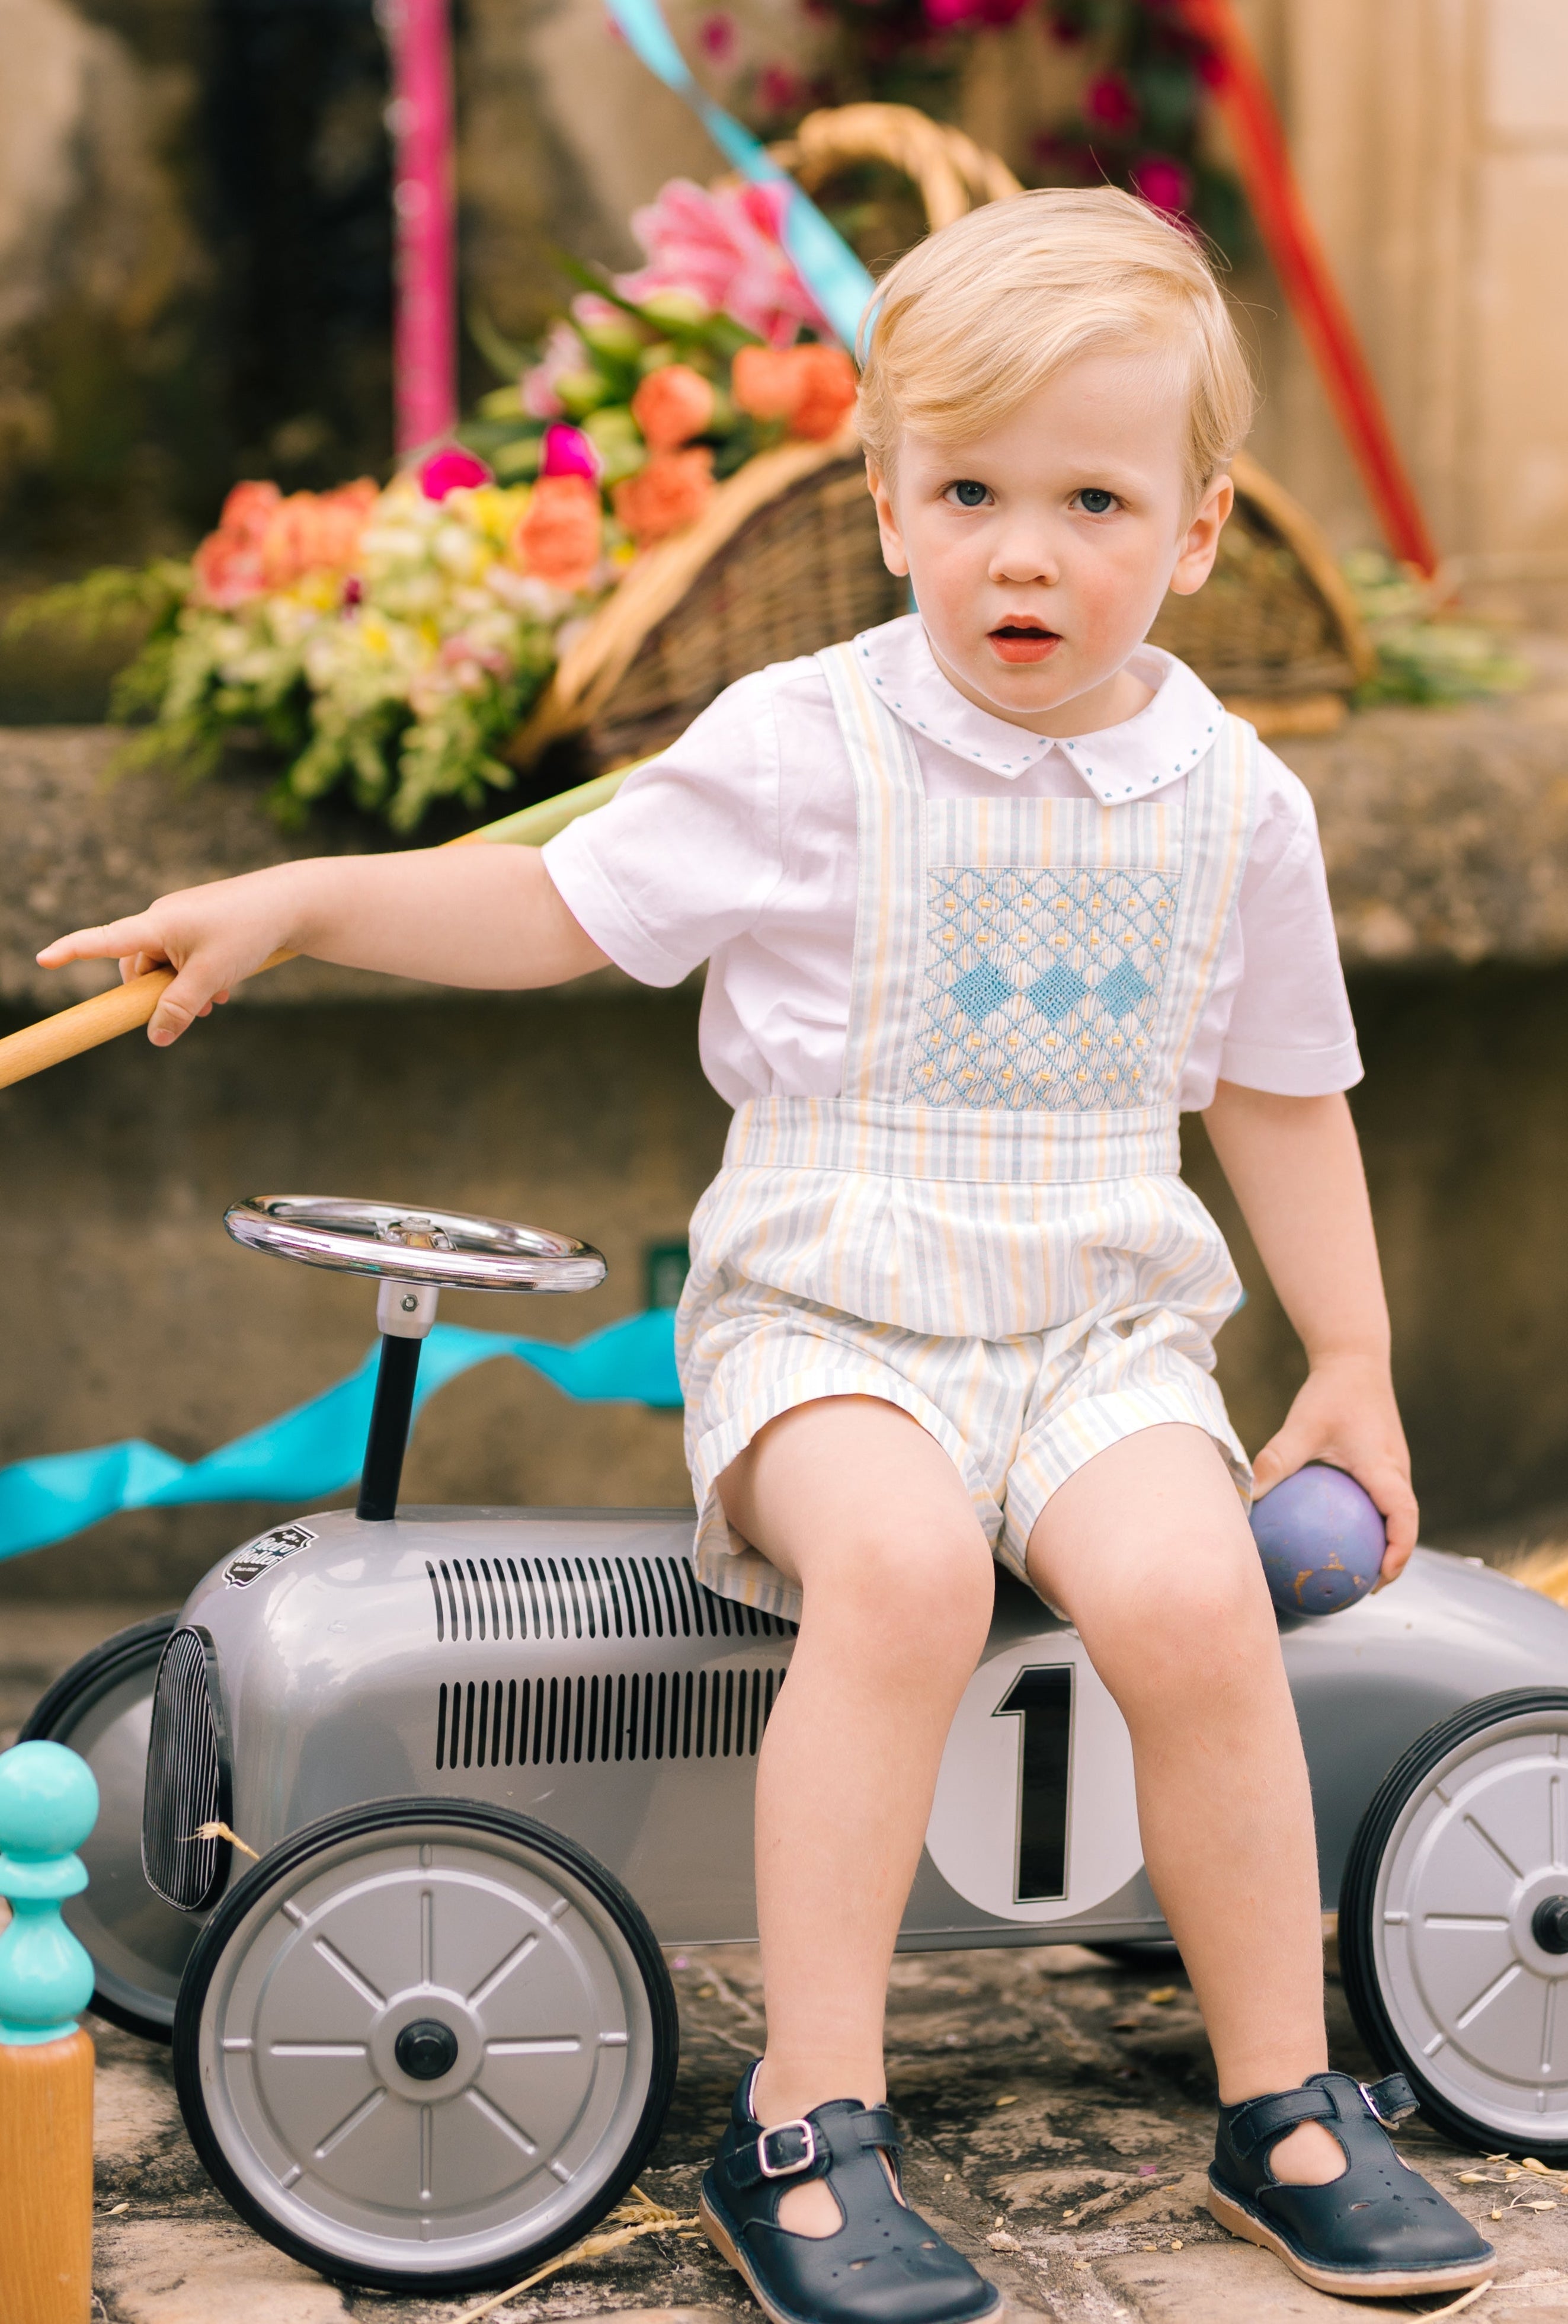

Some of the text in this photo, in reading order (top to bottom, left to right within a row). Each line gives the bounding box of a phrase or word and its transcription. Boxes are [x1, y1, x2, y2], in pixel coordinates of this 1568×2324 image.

[254, 1537, 296, 1553] Retro
[234, 1548, 283, 1565] Roller
[990, 1663, 1076, 1904] 1
